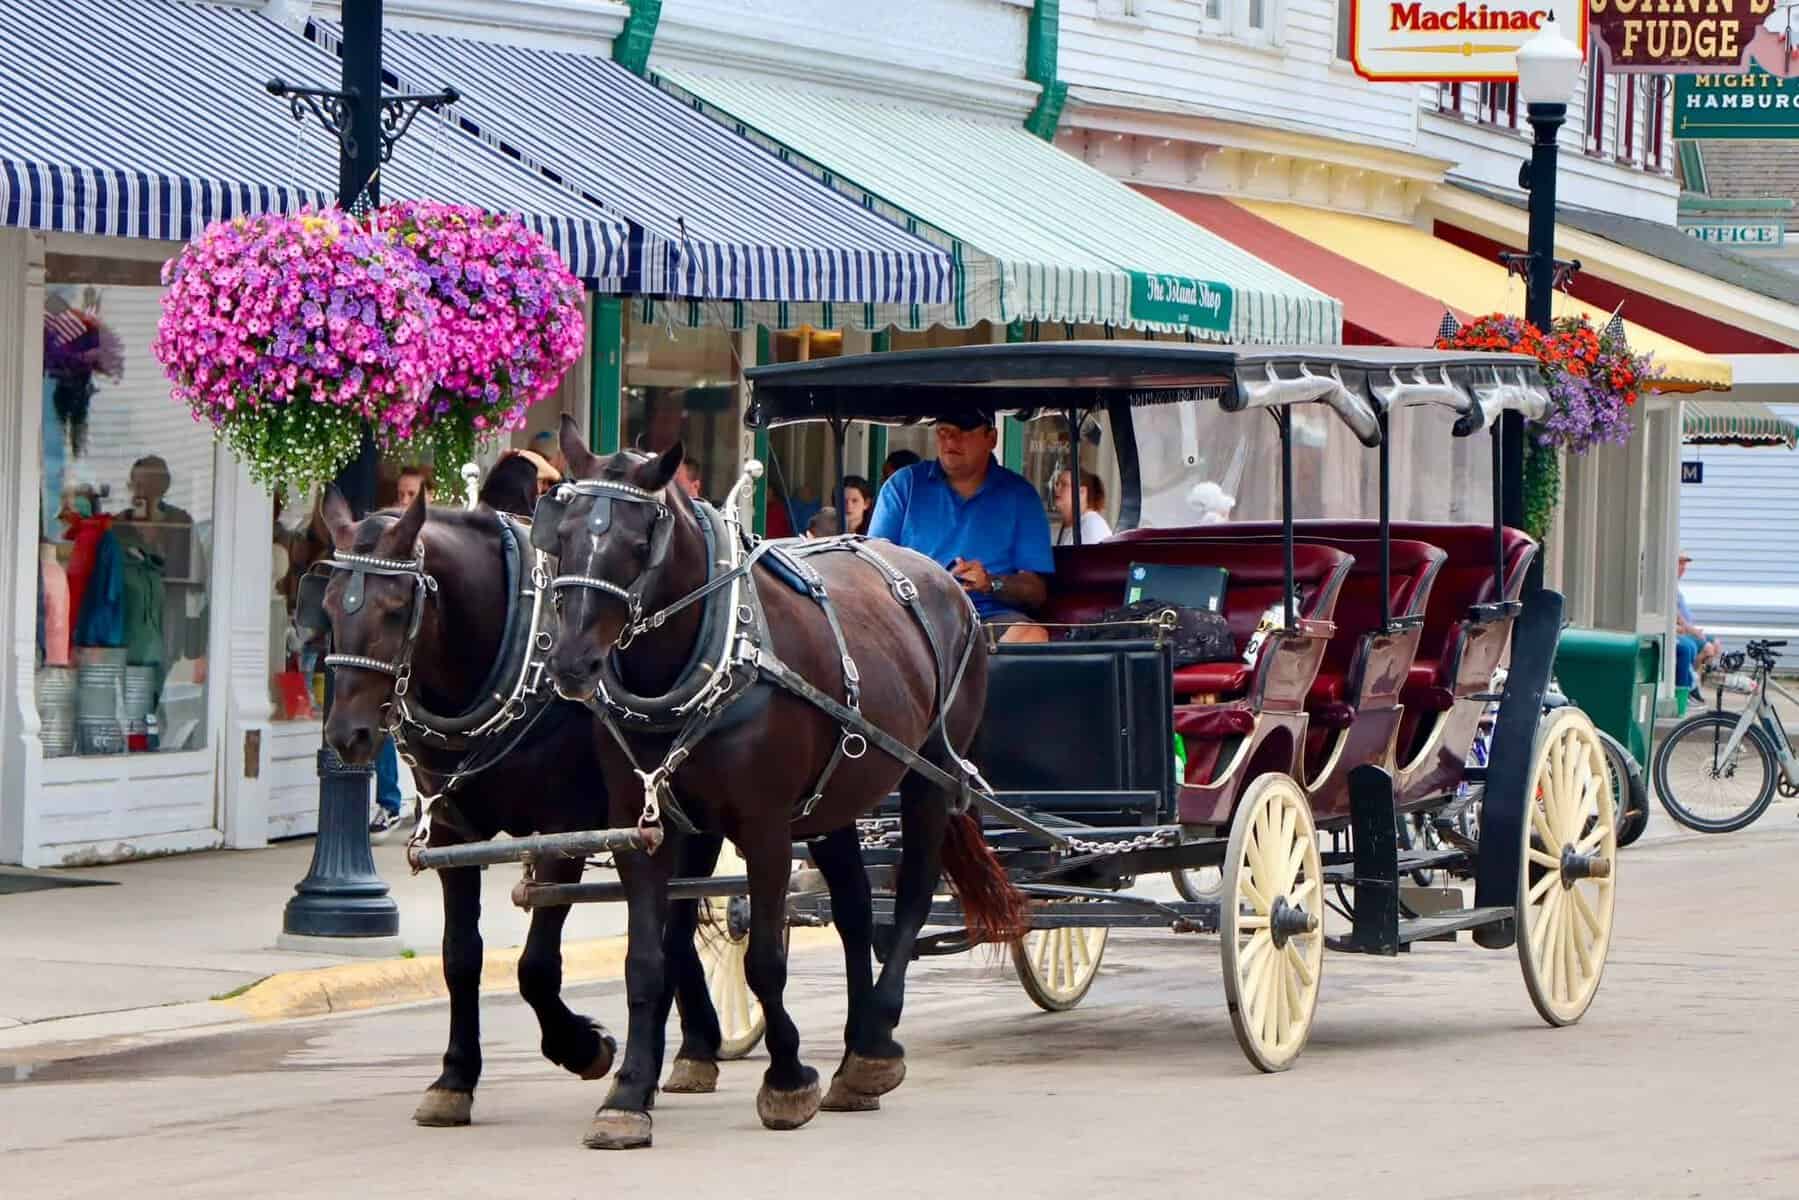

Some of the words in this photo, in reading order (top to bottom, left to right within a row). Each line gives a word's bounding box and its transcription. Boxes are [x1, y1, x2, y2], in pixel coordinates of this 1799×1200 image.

[1390, 2, 1547, 31] Mackinac
[1621, 19, 1740, 58] FUDGE
[1695, 74, 1785, 88] MIGHTY
[1685, 226, 1774, 241] OFFICE
[1146, 275, 1164, 301] The
[1165, 277, 1197, 305] Island
[1198, 281, 1221, 318] Shop
